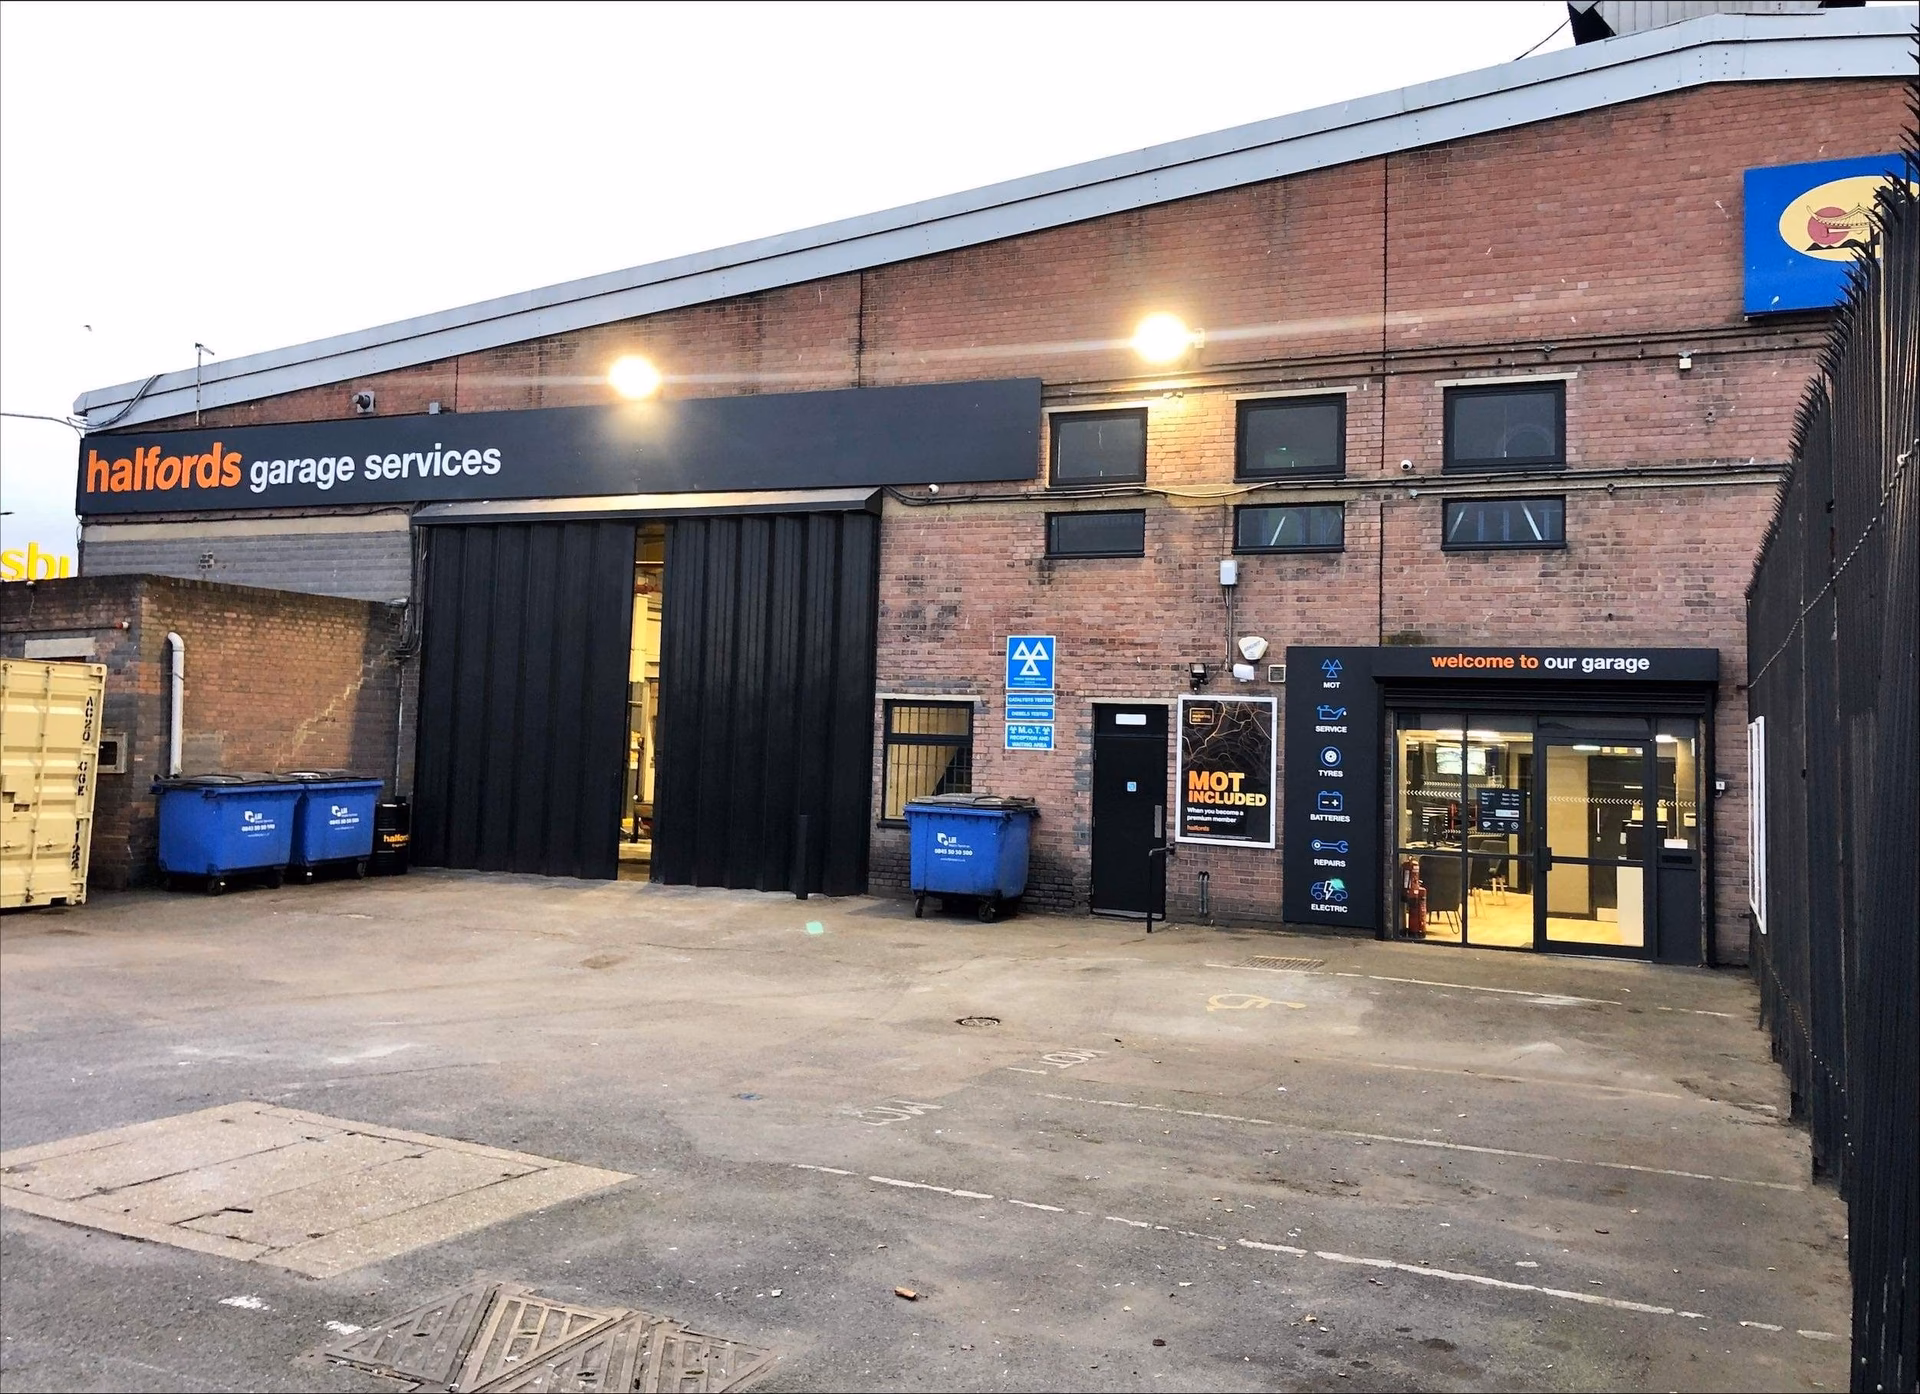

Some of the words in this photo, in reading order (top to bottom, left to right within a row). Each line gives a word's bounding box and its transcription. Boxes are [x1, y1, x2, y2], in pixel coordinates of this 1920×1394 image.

[86, 442, 242, 493] halfords
[250, 455, 355, 494] garage
[364, 442, 502, 481] services
[1431, 653, 1515, 669] welcome
[1519, 654, 1539, 669] to
[1544, 656, 1577, 670] our
[1581, 656, 1650, 674] garage
[1323, 681, 1341, 689] MOT
[1315, 725, 1348, 733] SERVICE
[1318, 770, 1344, 778] TYRES
[1188, 770, 1245, 792] MOT
[1188, 790, 1267, 807] INCLUDED
[1310, 813, 1351, 823] BATTERIES
[1313, 859, 1346, 868] REPAIRS
[1311, 903, 1348, 913] ELECTRIC
